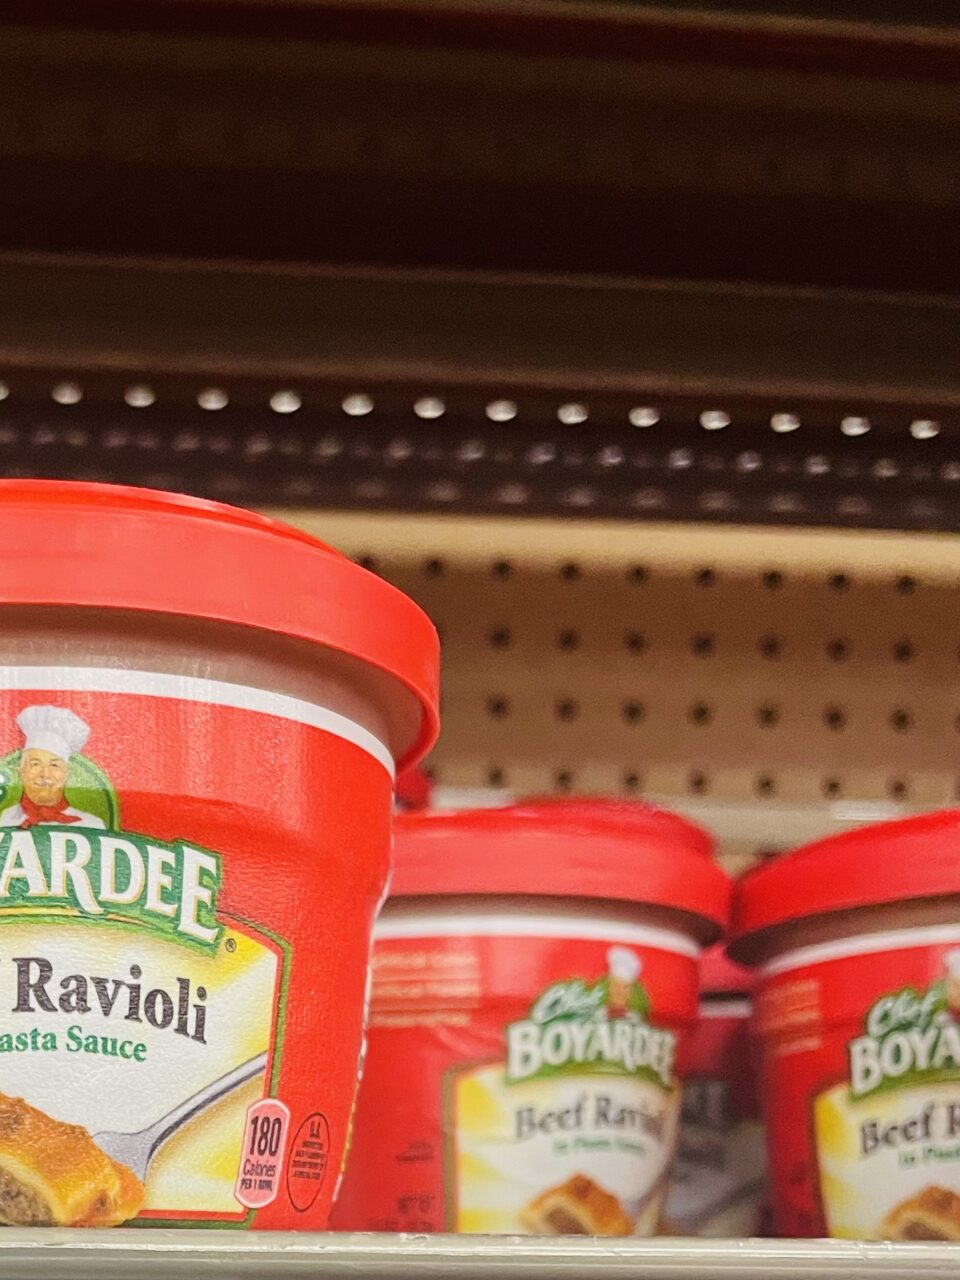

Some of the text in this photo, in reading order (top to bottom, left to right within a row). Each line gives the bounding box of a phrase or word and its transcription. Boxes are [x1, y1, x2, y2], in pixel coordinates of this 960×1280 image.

[12, 957, 207, 1045] Ravioli
[66, 1025, 147, 1062] Sauce
[249, 1116, 281, 1156] 180
[243, 1159, 276, 1177] Calories
